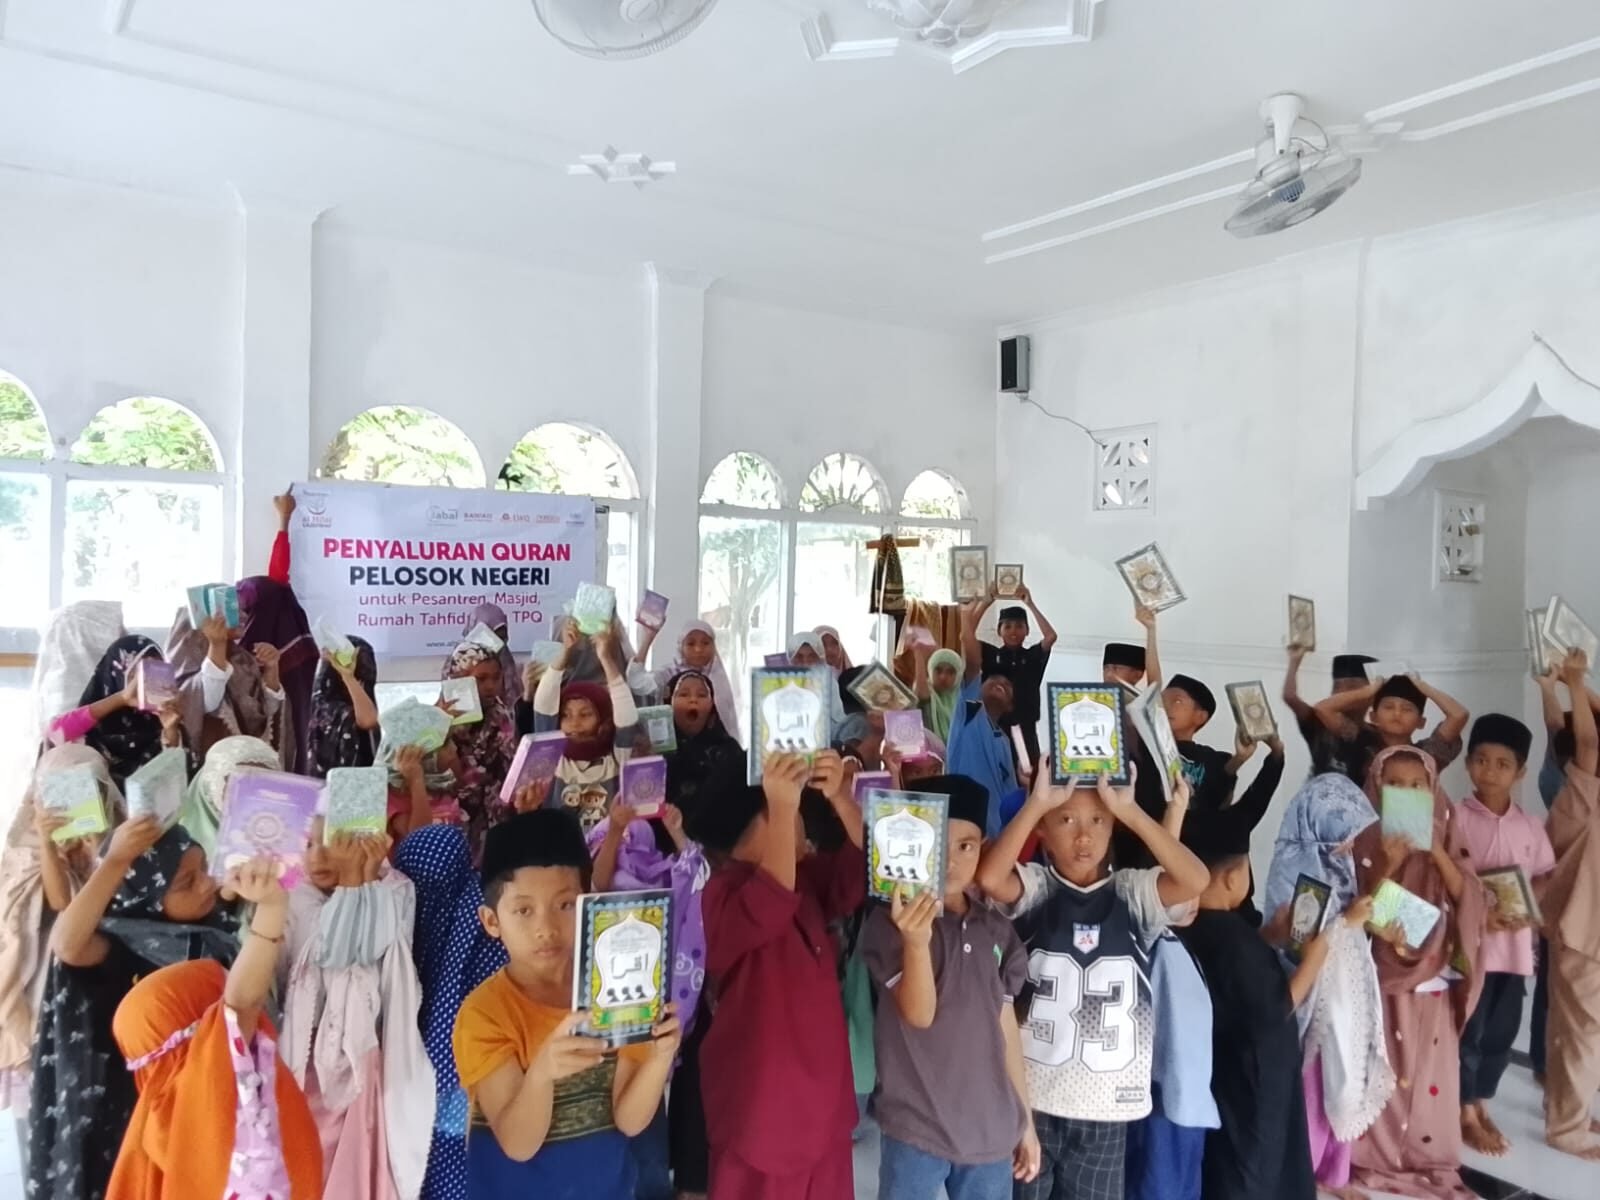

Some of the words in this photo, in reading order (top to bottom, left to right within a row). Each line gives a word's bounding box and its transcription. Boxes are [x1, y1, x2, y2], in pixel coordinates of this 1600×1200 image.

[323, 538, 485, 561] PENYALURAN
[491, 543, 571, 562] QURAN
[349, 566, 464, 586] PELOSOK
[471, 567, 551, 586] NEGERI
[359, 593, 406, 606] untuk
[494, 592, 541, 608] Masjid,
[358, 613, 415, 627] Rumah
[419, 612, 471, 626] Tahfid
[512, 611, 543, 624] TPQ
[1020, 949, 1138, 1073] 33
